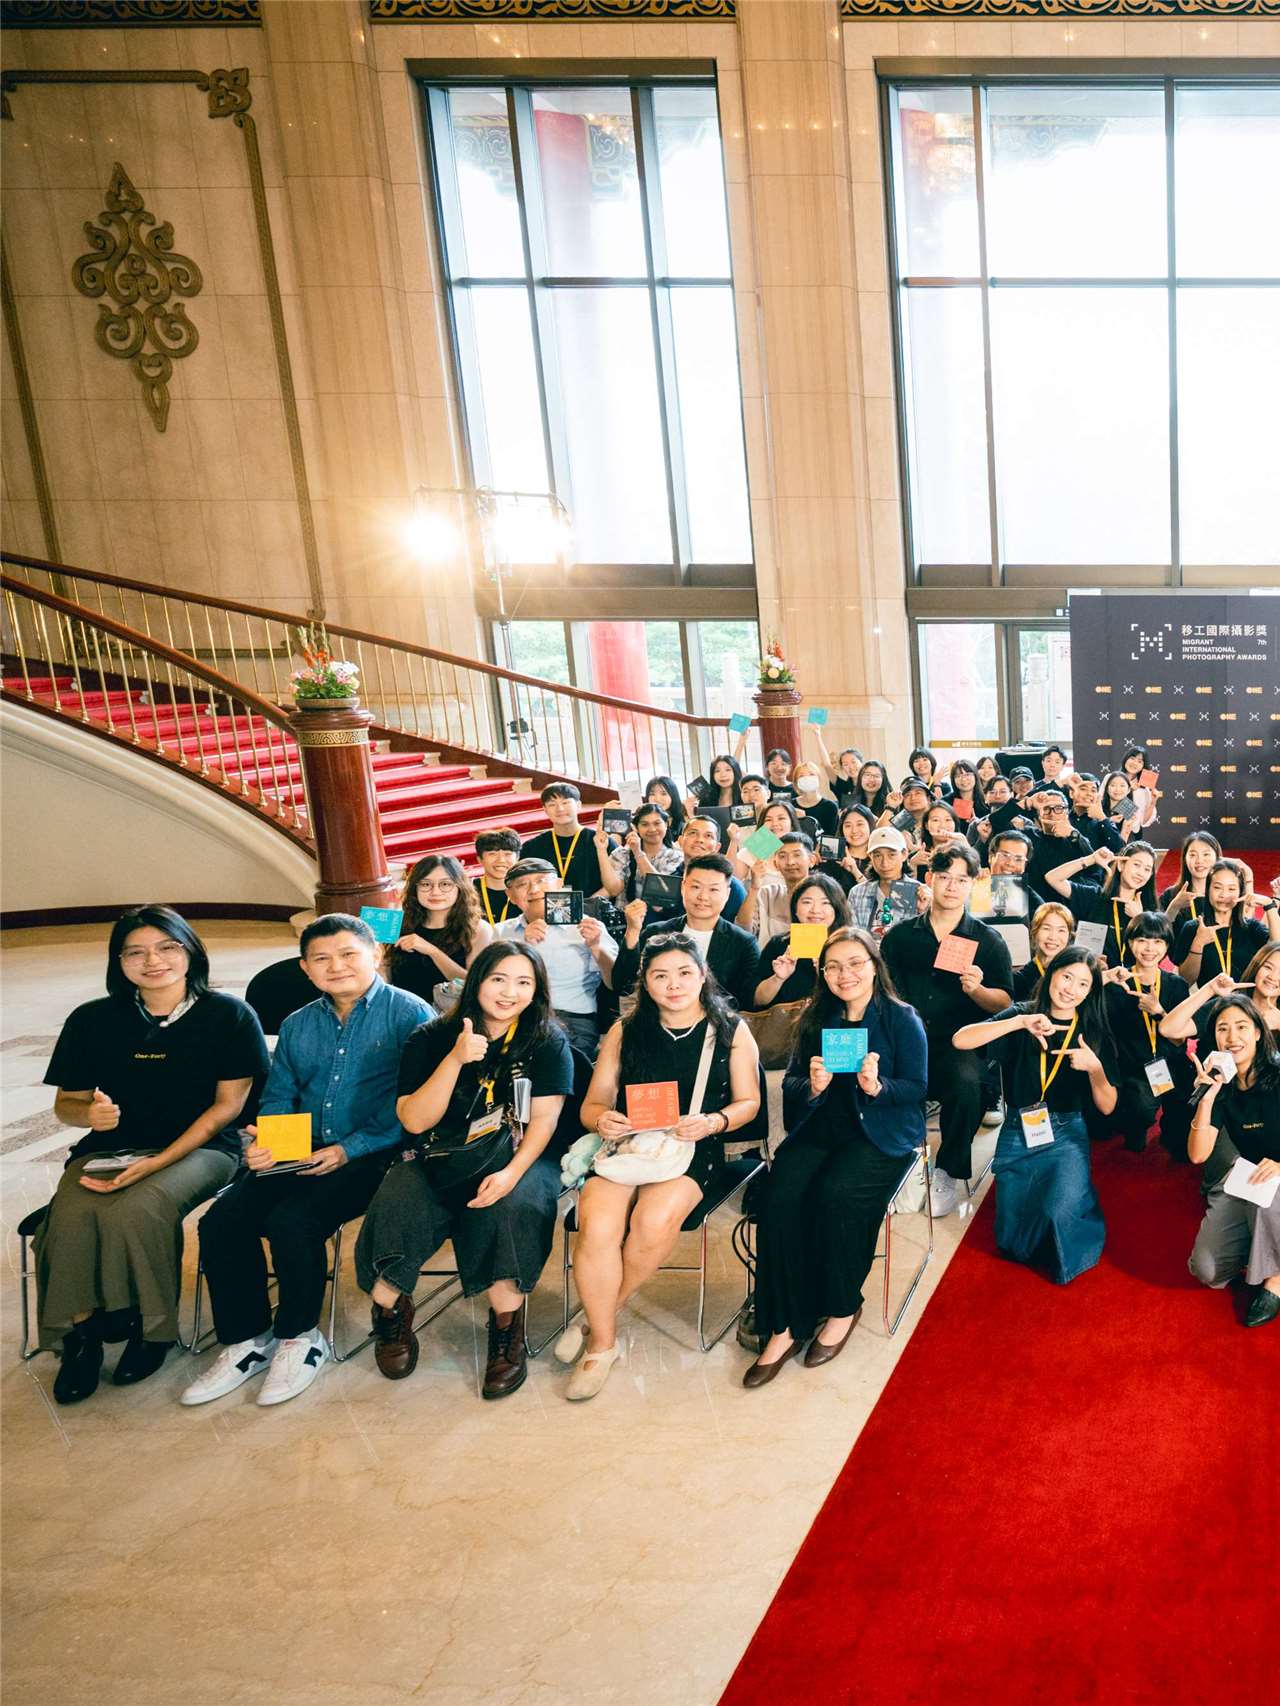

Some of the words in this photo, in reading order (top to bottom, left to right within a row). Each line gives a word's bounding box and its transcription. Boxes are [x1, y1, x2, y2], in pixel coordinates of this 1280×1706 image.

[1182, 625, 1267, 636] 移工國際攝影獎
